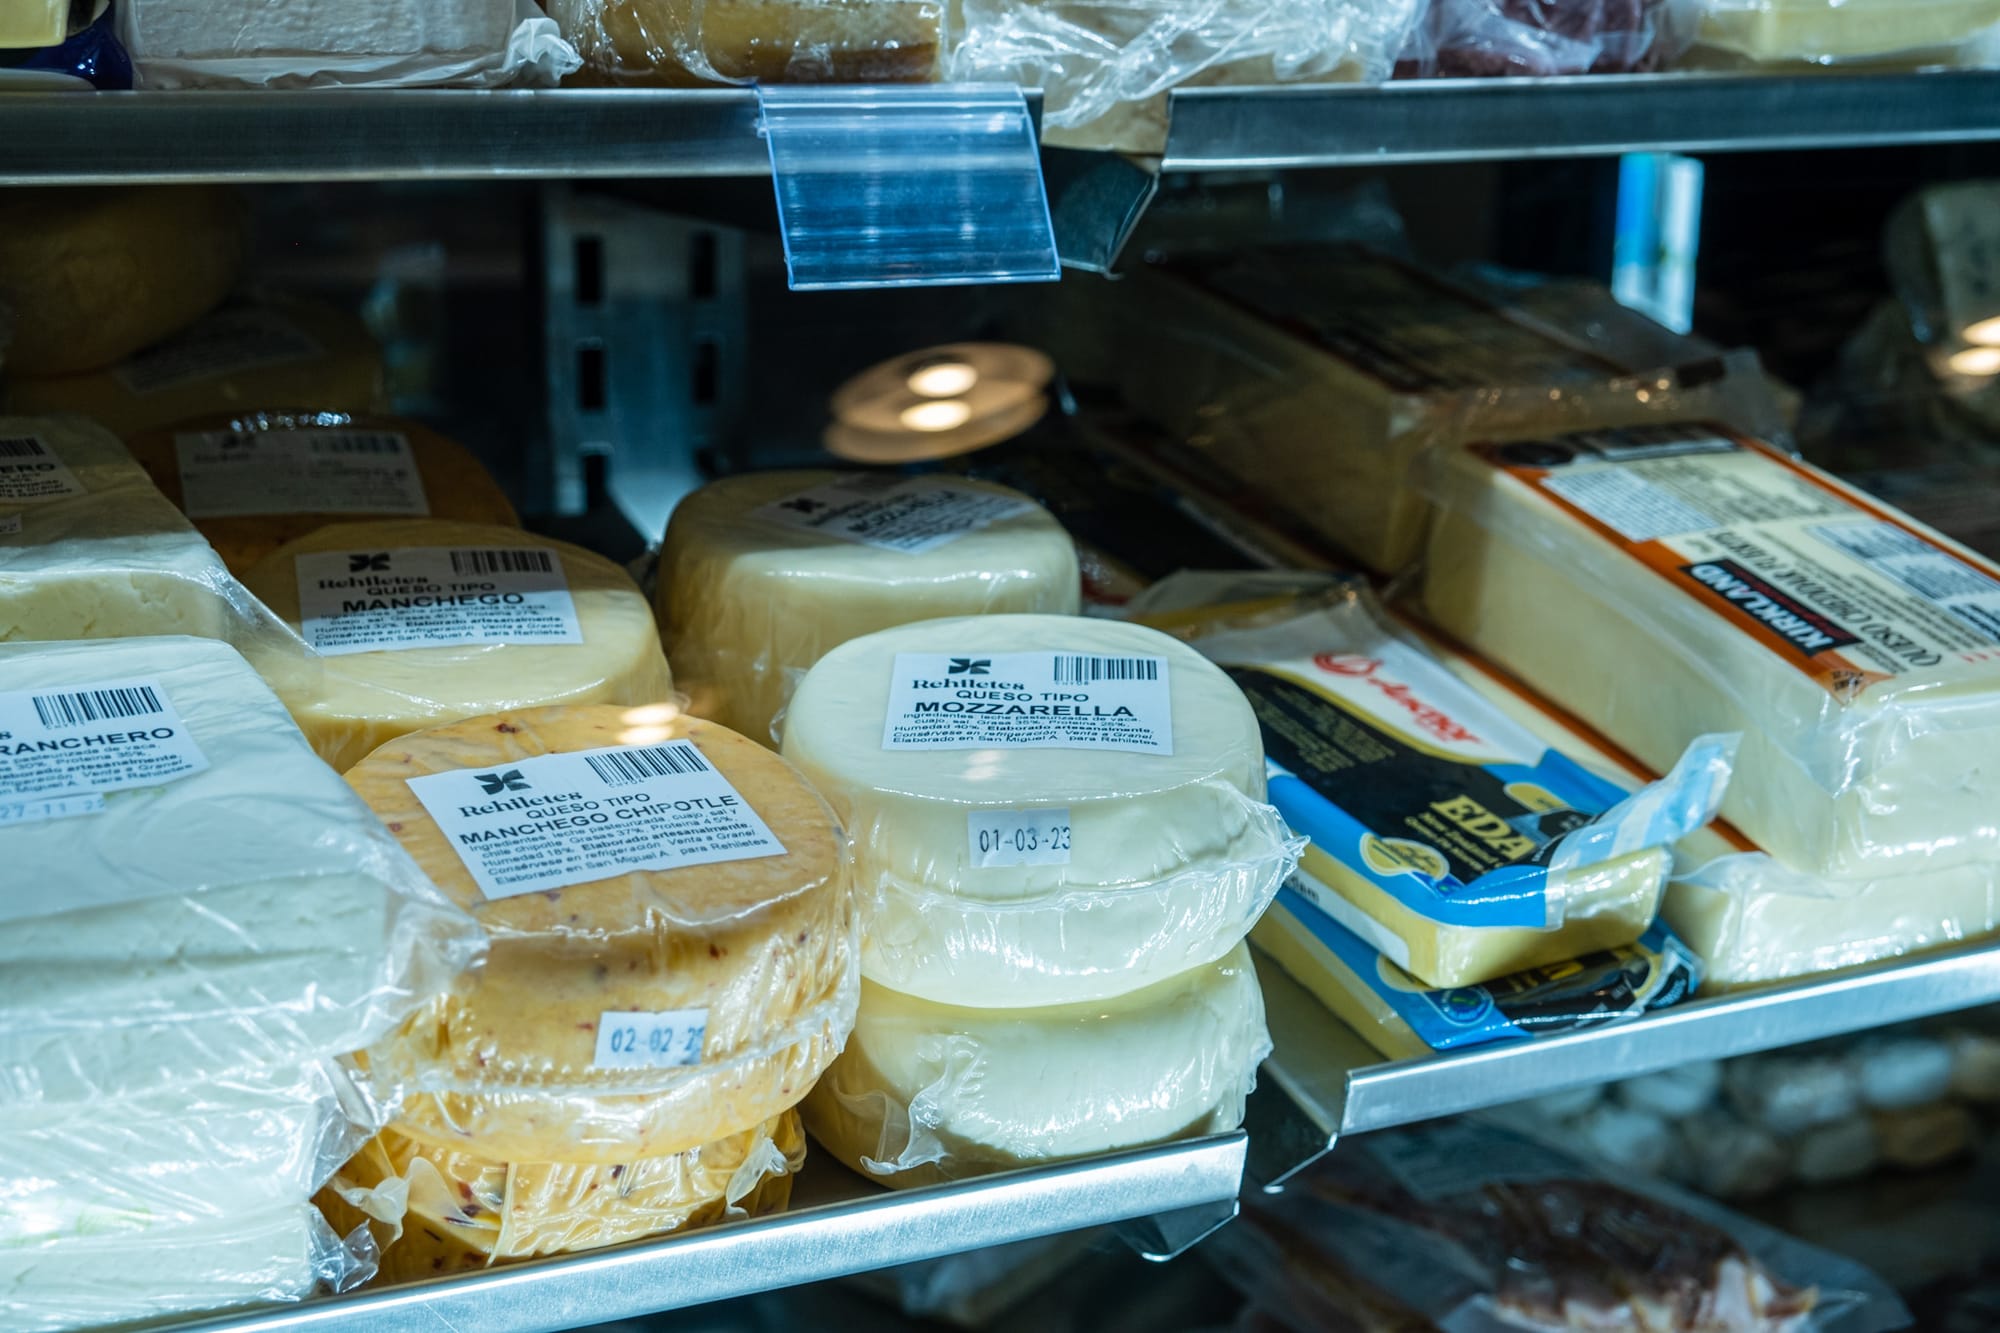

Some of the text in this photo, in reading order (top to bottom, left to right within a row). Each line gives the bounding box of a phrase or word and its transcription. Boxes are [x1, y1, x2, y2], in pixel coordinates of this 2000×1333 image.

[318, 576, 428, 590] Rehiletes
[367, 582, 496, 596] QUESO TIPO
[342, 592, 524, 613] MANCHEGO
[1690, 563, 1836, 651] KIRKLAND
[406, 619, 467, 628] Elaborado
[315, 638, 374, 647] Elaborado
[912, 678, 1025, 690] Rehiletes
[956, 690, 1089, 702] QUESO TIPO
[915, 702, 1134, 717] MOZZARELLA
[893, 730, 962, 738] Consérvese
[1101, 736, 1158, 746] Rehiletes
[458, 792, 583, 818] Rehiletes
[526, 793, 651, 819] QUESO TIPO
[459, 795, 739, 845] MANCHEGO CHIPOTLE
[552, 828, 585, 839] leche
[710, 808, 727, 816] sal
[482, 848, 511, 860] chile
[569, 832, 614, 846] Grasas
[482, 853, 544, 869] Humedad
[581, 835, 649, 852] Elaborado
[488, 859, 563, 877] Consérvese
[566, 854, 582, 863] en
[667, 835, 702, 847] Venta
[495, 868, 562, 885] Elaborado
[566, 865, 583, 873] en
[586, 858, 612, 871] San
[614, 852, 657, 866] Miguel
[680, 845, 708, 855] para
[710, 839, 768, 852] Rehiletes
